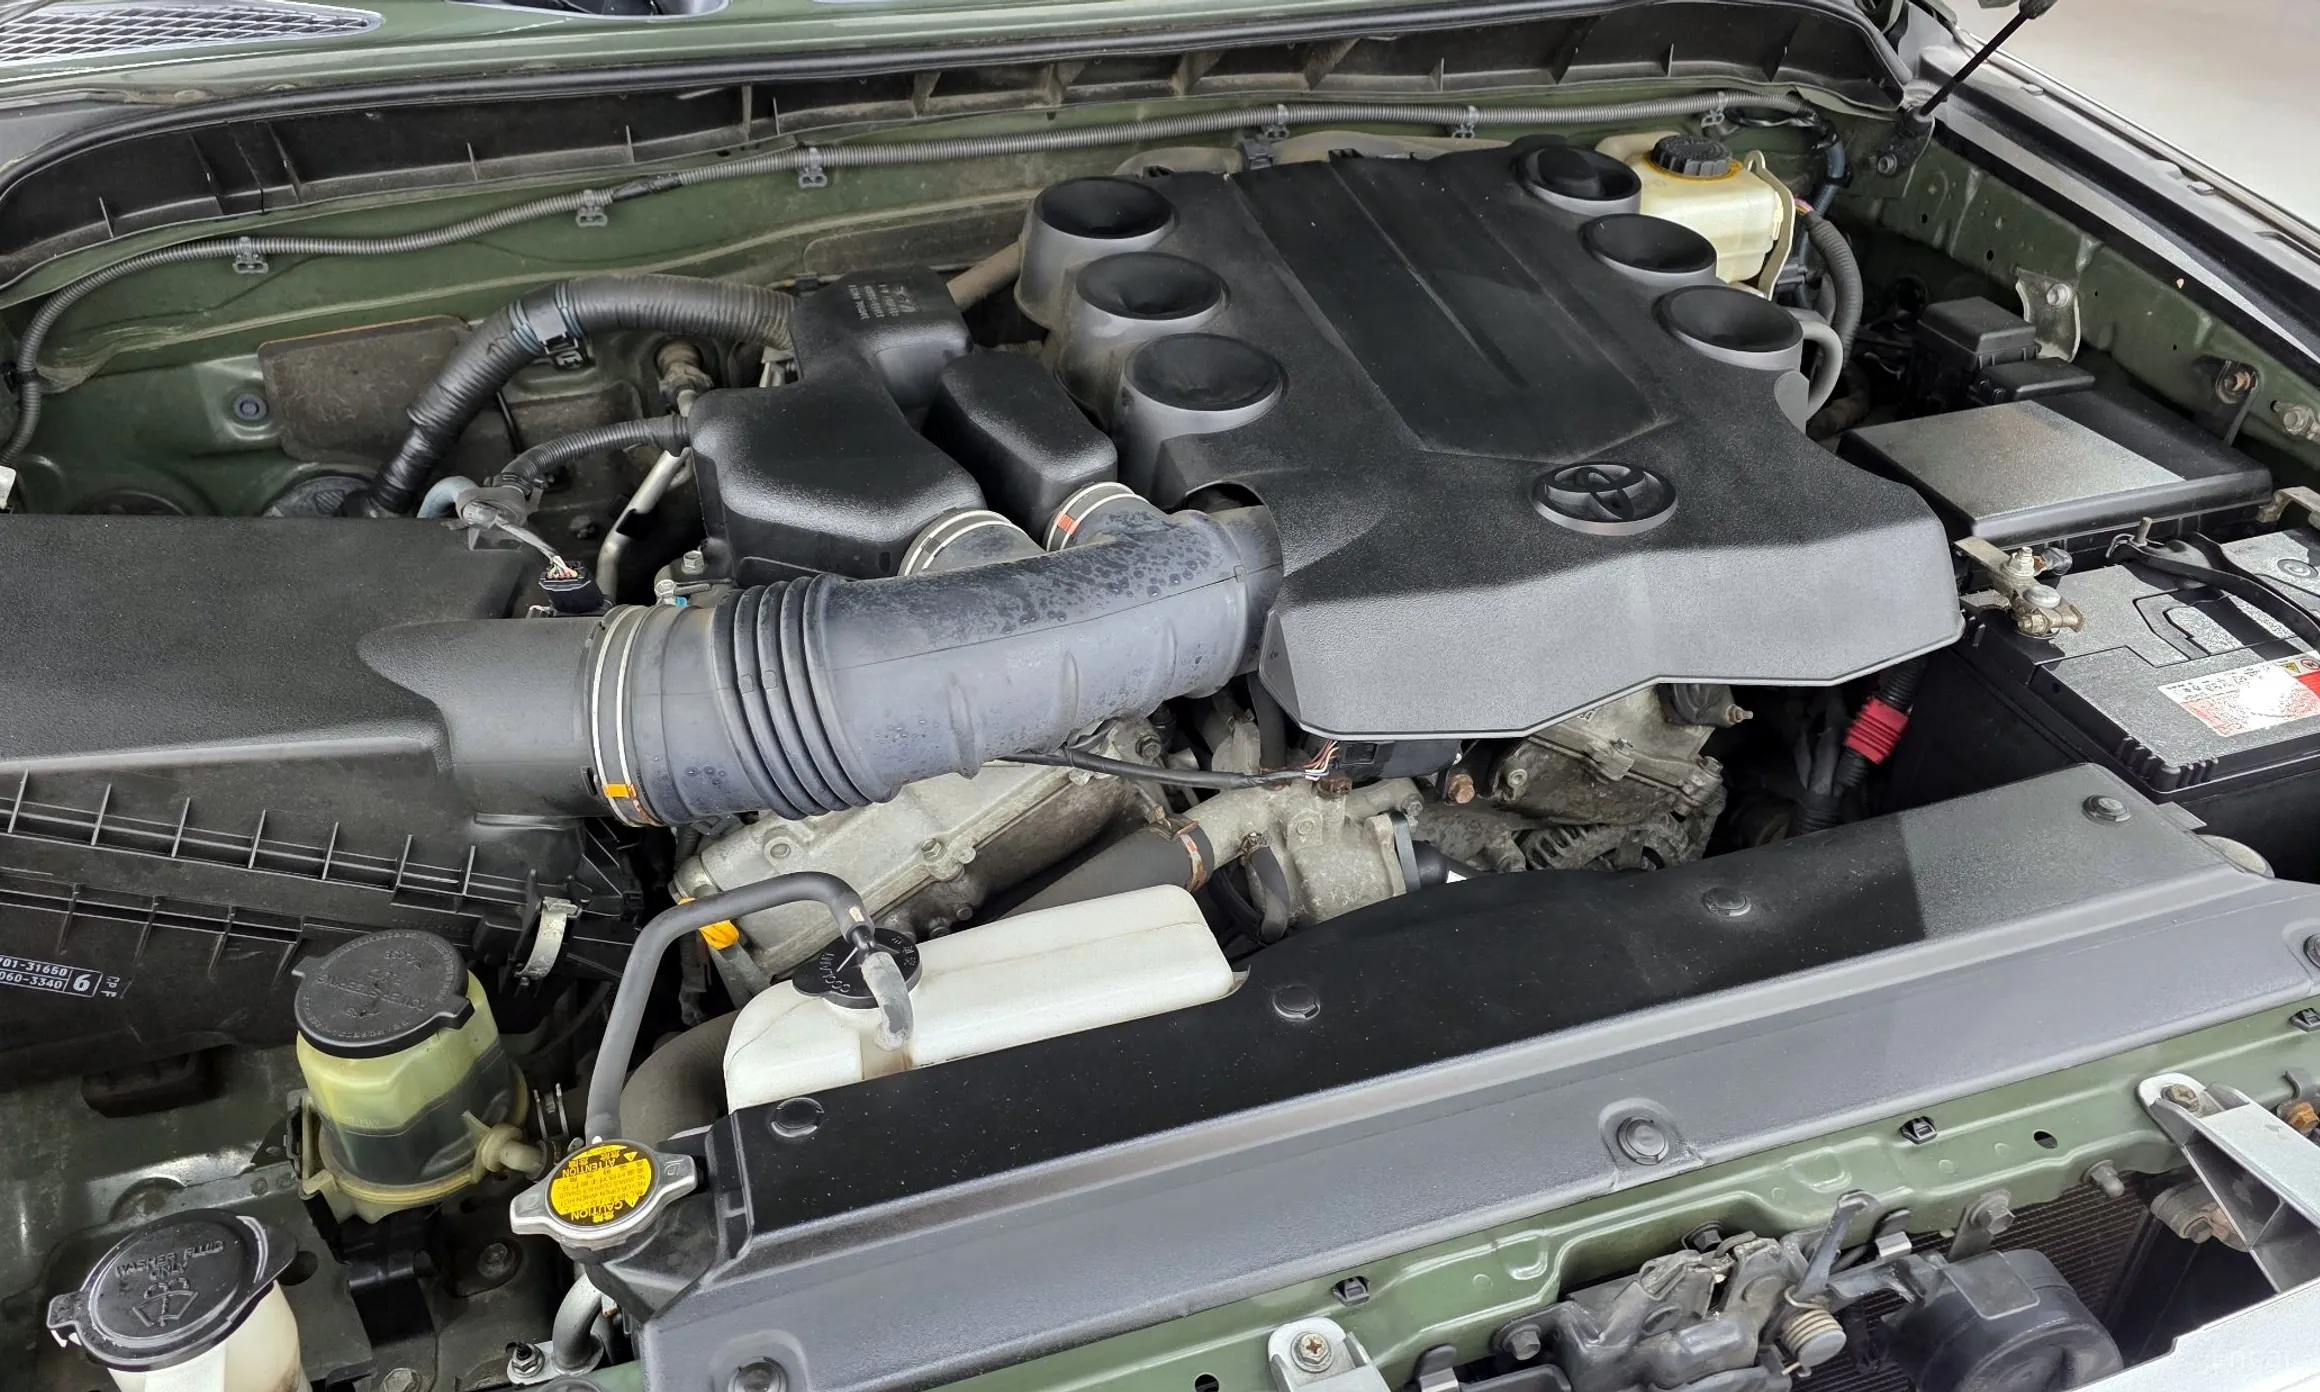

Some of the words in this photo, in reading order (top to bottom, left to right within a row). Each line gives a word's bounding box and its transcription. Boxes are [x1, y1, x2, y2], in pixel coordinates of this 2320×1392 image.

[73, 974, 91, 992] 6
[562, 1158, 616, 1178] ATTENTION
[570, 1200, 623, 1221] CAUTION
[116, 1252, 177, 1278] WASHER
[184, 1240, 224, 1260] FLUID
[149, 1261, 188, 1280] ONLY
